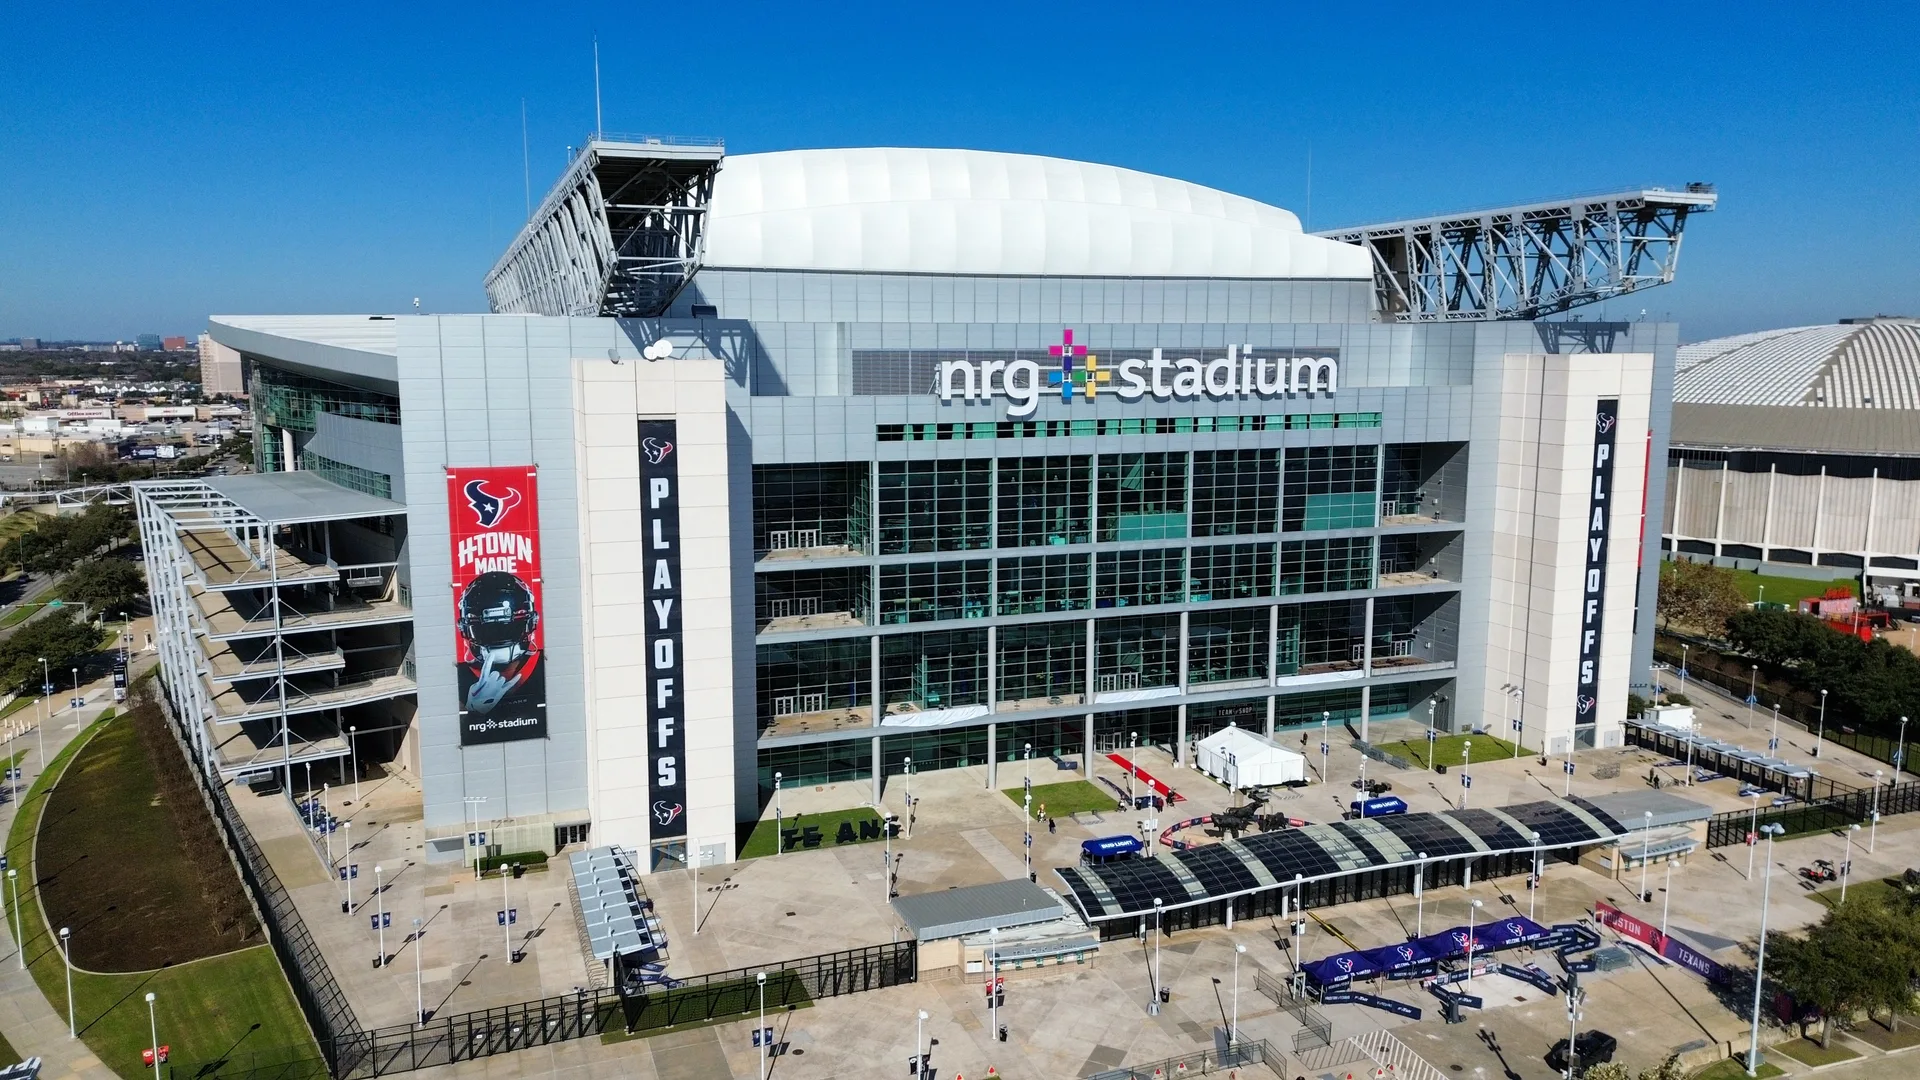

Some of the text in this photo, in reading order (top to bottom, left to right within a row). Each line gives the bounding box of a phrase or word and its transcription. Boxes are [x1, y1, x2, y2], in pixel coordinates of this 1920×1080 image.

[941, 344, 1338, 416] nrg stadium
[474, 555, 518, 575] MADE
[1580, 443, 1610, 685] PLAYOFFS
[649, 477, 677, 787] PLAYOFFS
[1239, 706, 1253, 714] SHOP
[469, 717, 538, 733] nrg stadium
[1602, 909, 1641, 936] HOUSTON
[1678, 947, 1710, 975] TEXANS
